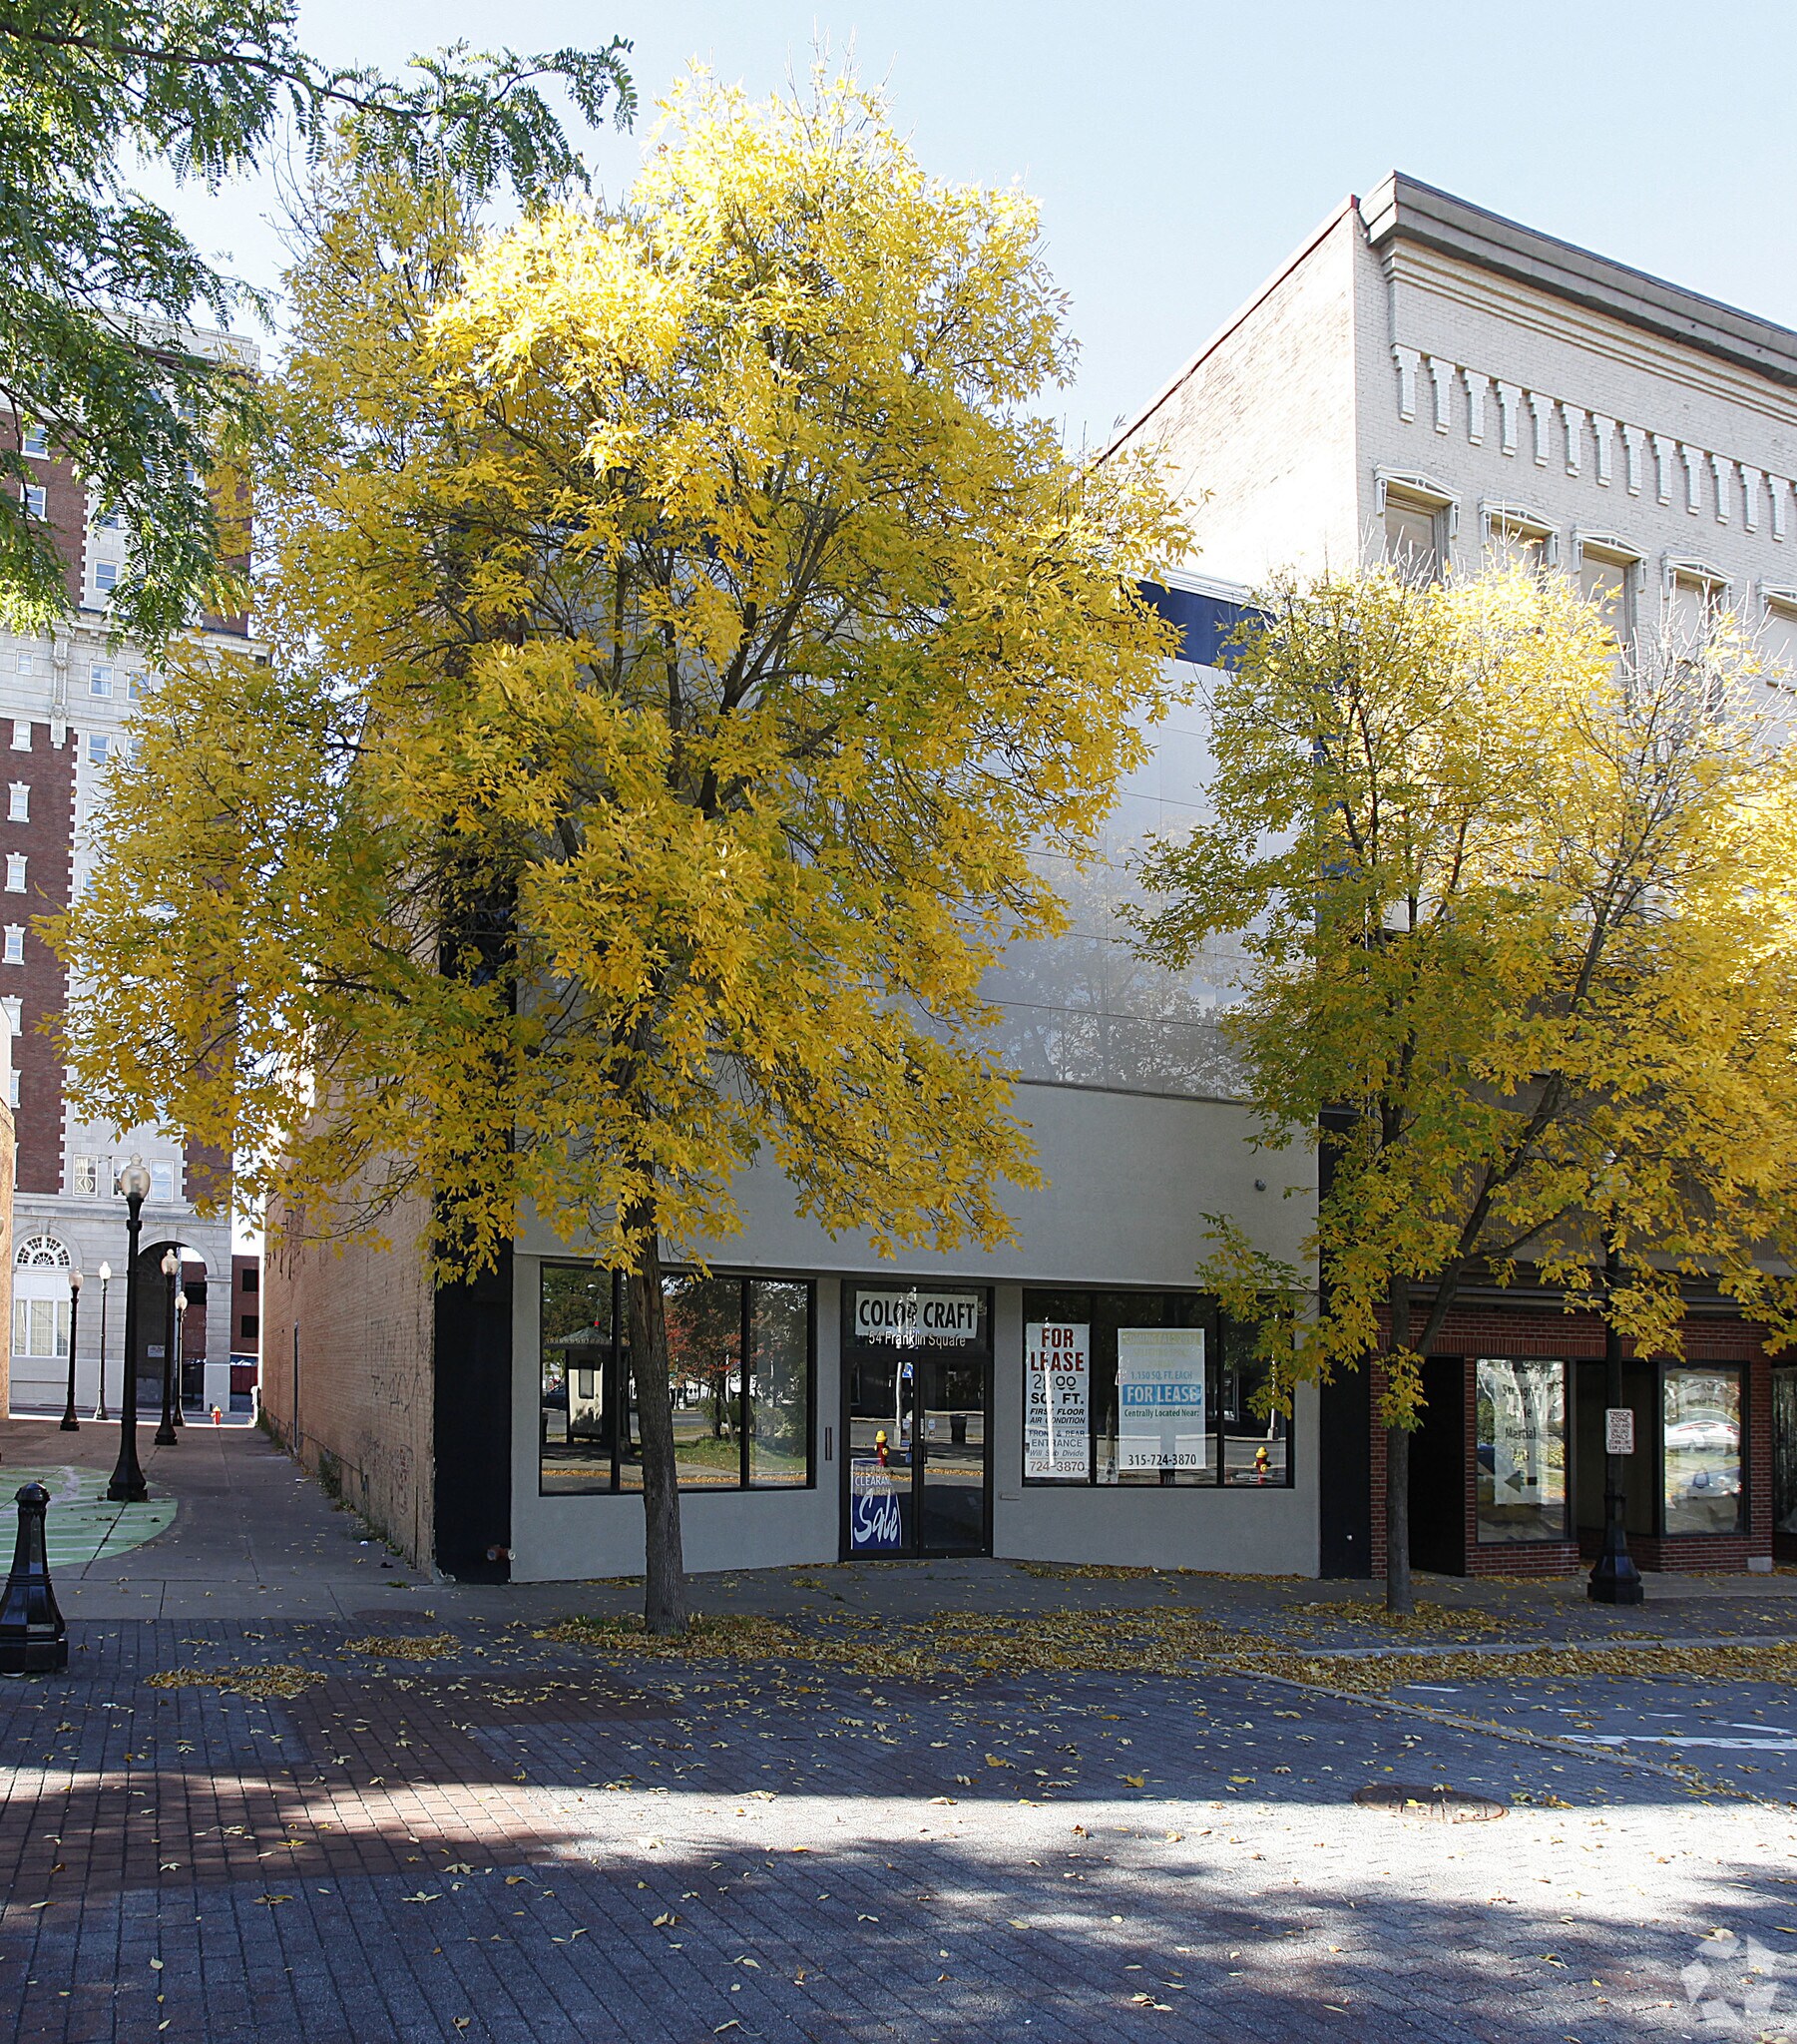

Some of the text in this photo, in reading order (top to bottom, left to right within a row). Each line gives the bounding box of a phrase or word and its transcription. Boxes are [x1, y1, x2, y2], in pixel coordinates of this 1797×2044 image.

[859, 1299, 975, 1329] COLOR CRAFT
[868, 1330, 966, 1349] 54 Franklin Square
[1041, 1327, 1074, 1348] FOR
[1030, 1350, 1085, 1372] LEASE
[1174, 1370, 1193, 1380] EACH
[1063, 1392, 1085, 1404] FT.
[1126, 1385, 1198, 1403] FOR LEASE
[1123, 1408, 1154, 1418] Centrally
[1154, 1408, 1180, 1417] Located
[1032, 1439, 1084, 1448] ENTRANCE
[1030, 1461, 1086, 1472] 724-3870
[1127, 1453, 1197, 1466] 315-724-3870
[854, 1487, 898, 1543] Sale
